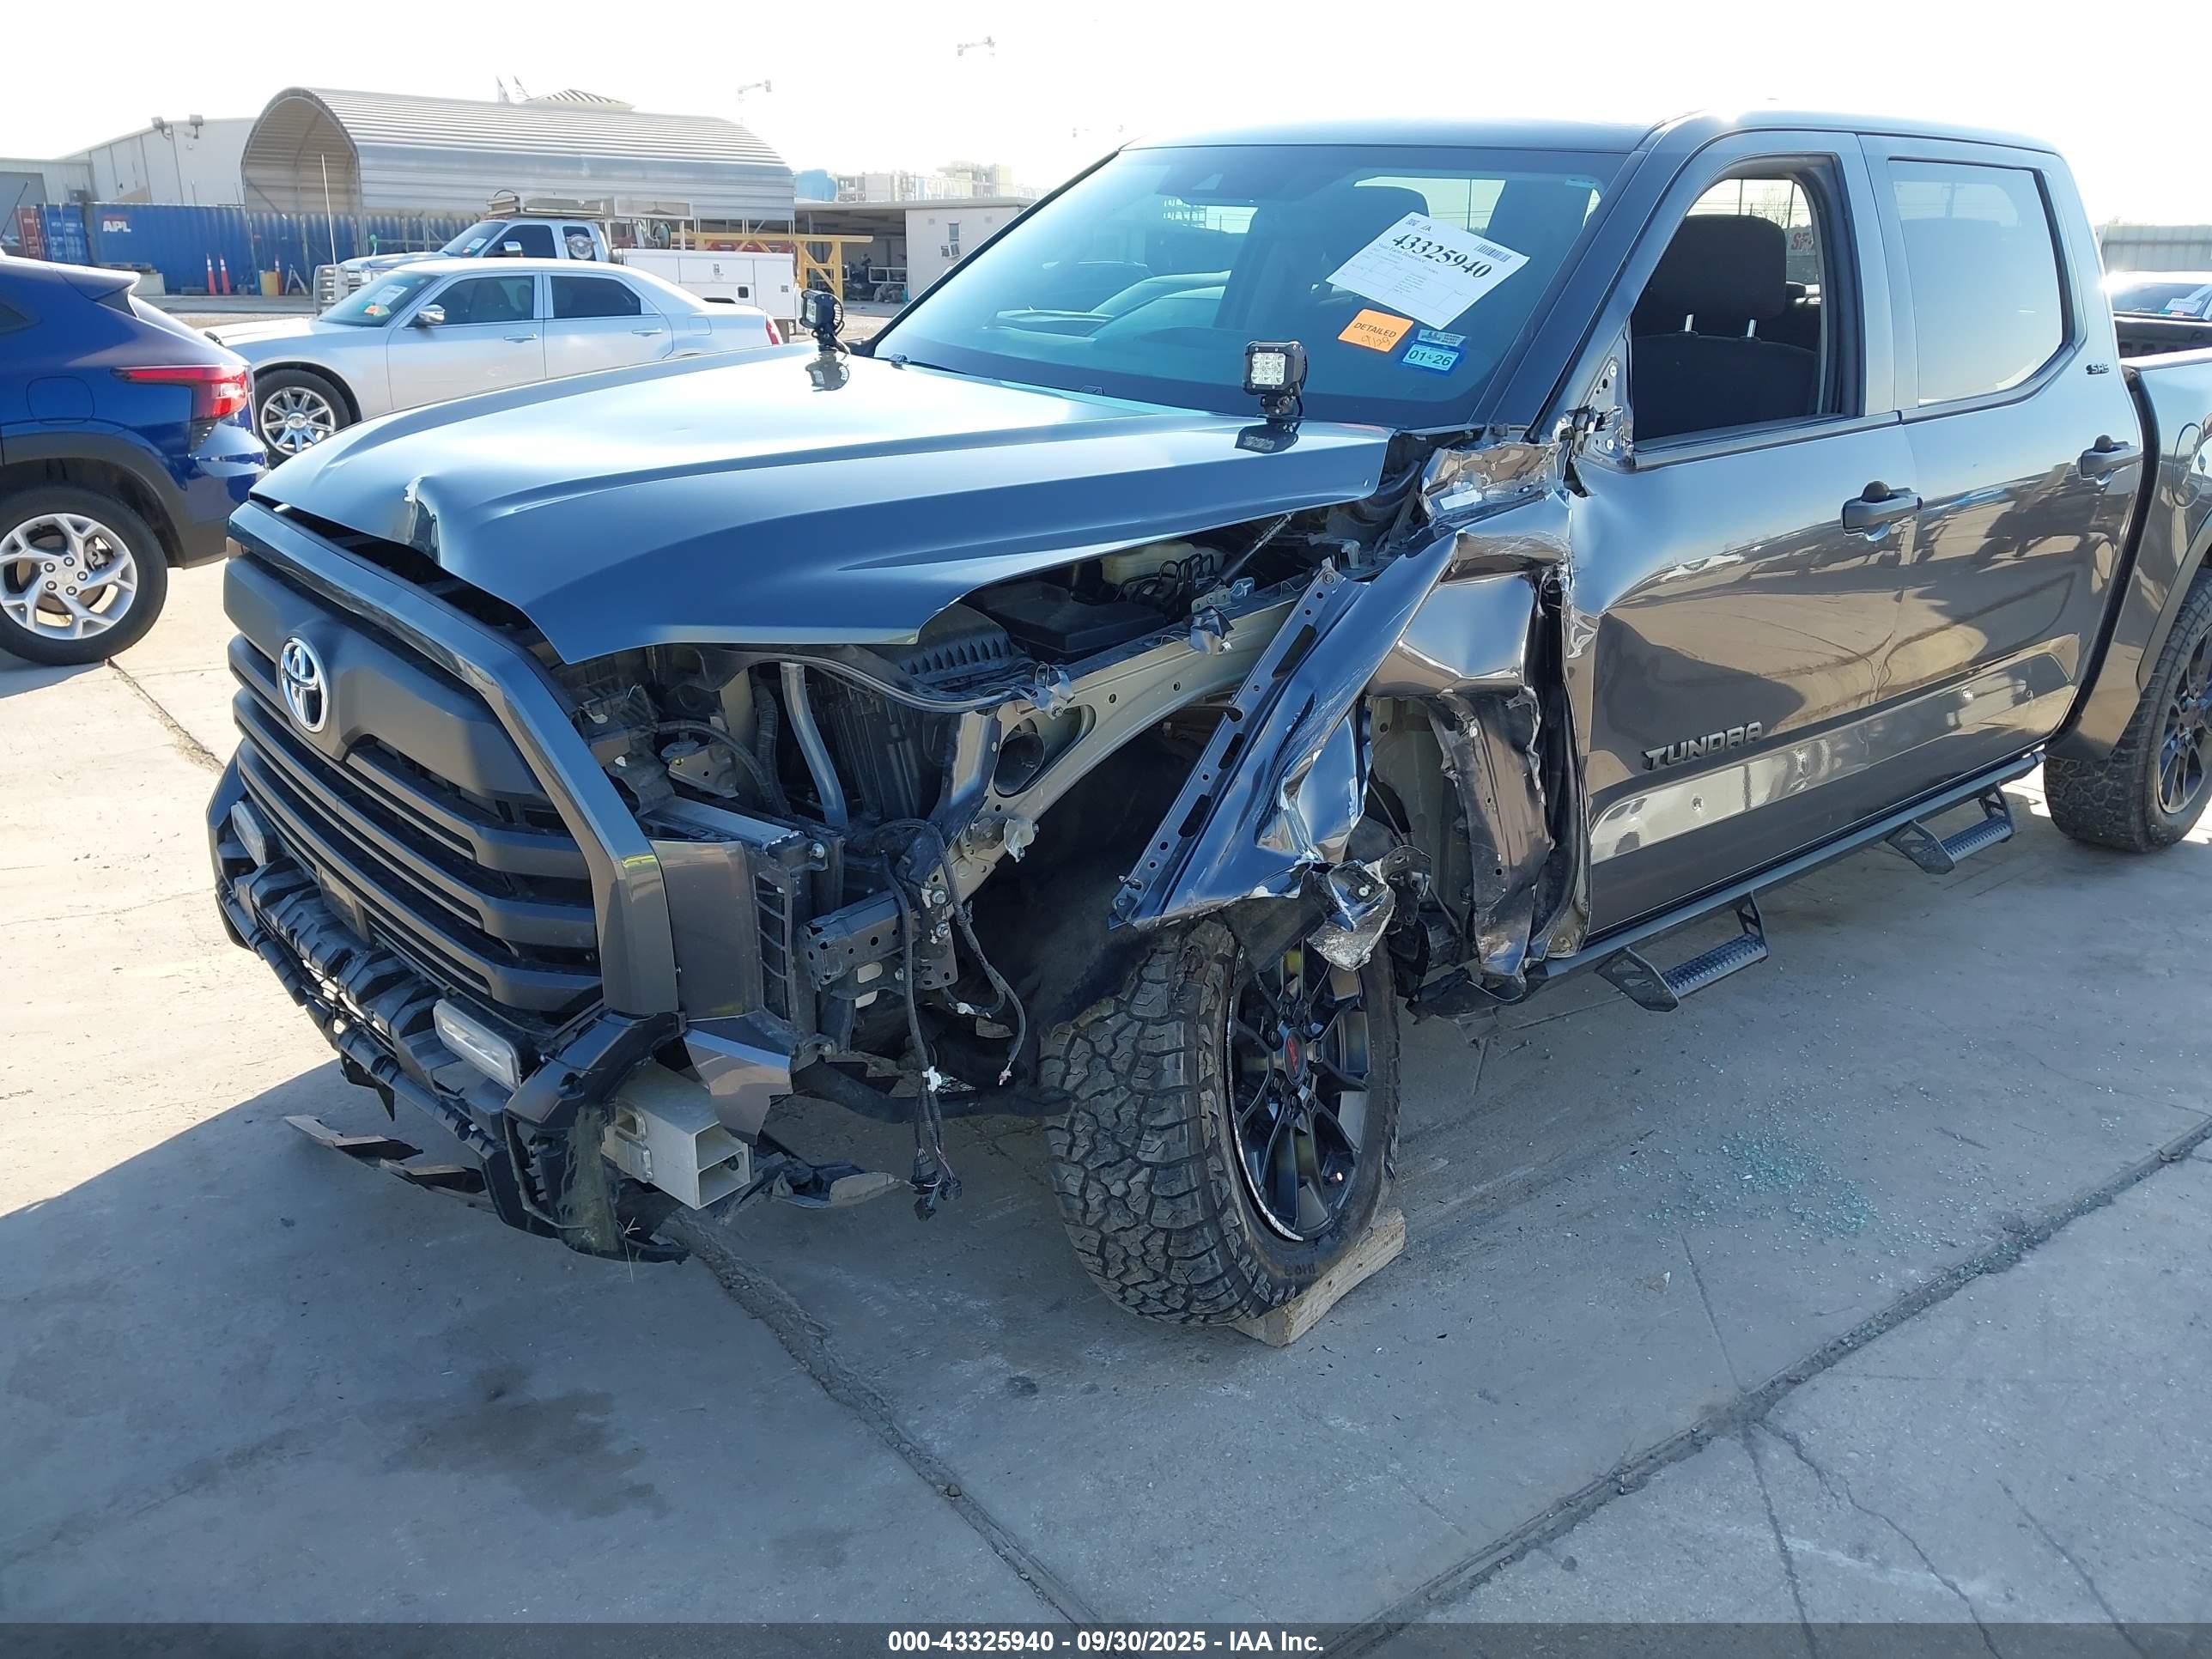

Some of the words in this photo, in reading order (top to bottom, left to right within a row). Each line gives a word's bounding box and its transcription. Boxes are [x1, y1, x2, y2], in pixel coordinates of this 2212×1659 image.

[102, 220, 131, 233] APL
[1392, 234, 1492, 278] 43325940
[1353, 322, 1397, 338] DETAILED
[1408, 349, 1426, 362] 01
[1432, 355, 1453, 367] 26
[1642, 720, 1764, 770] TUNDRA
